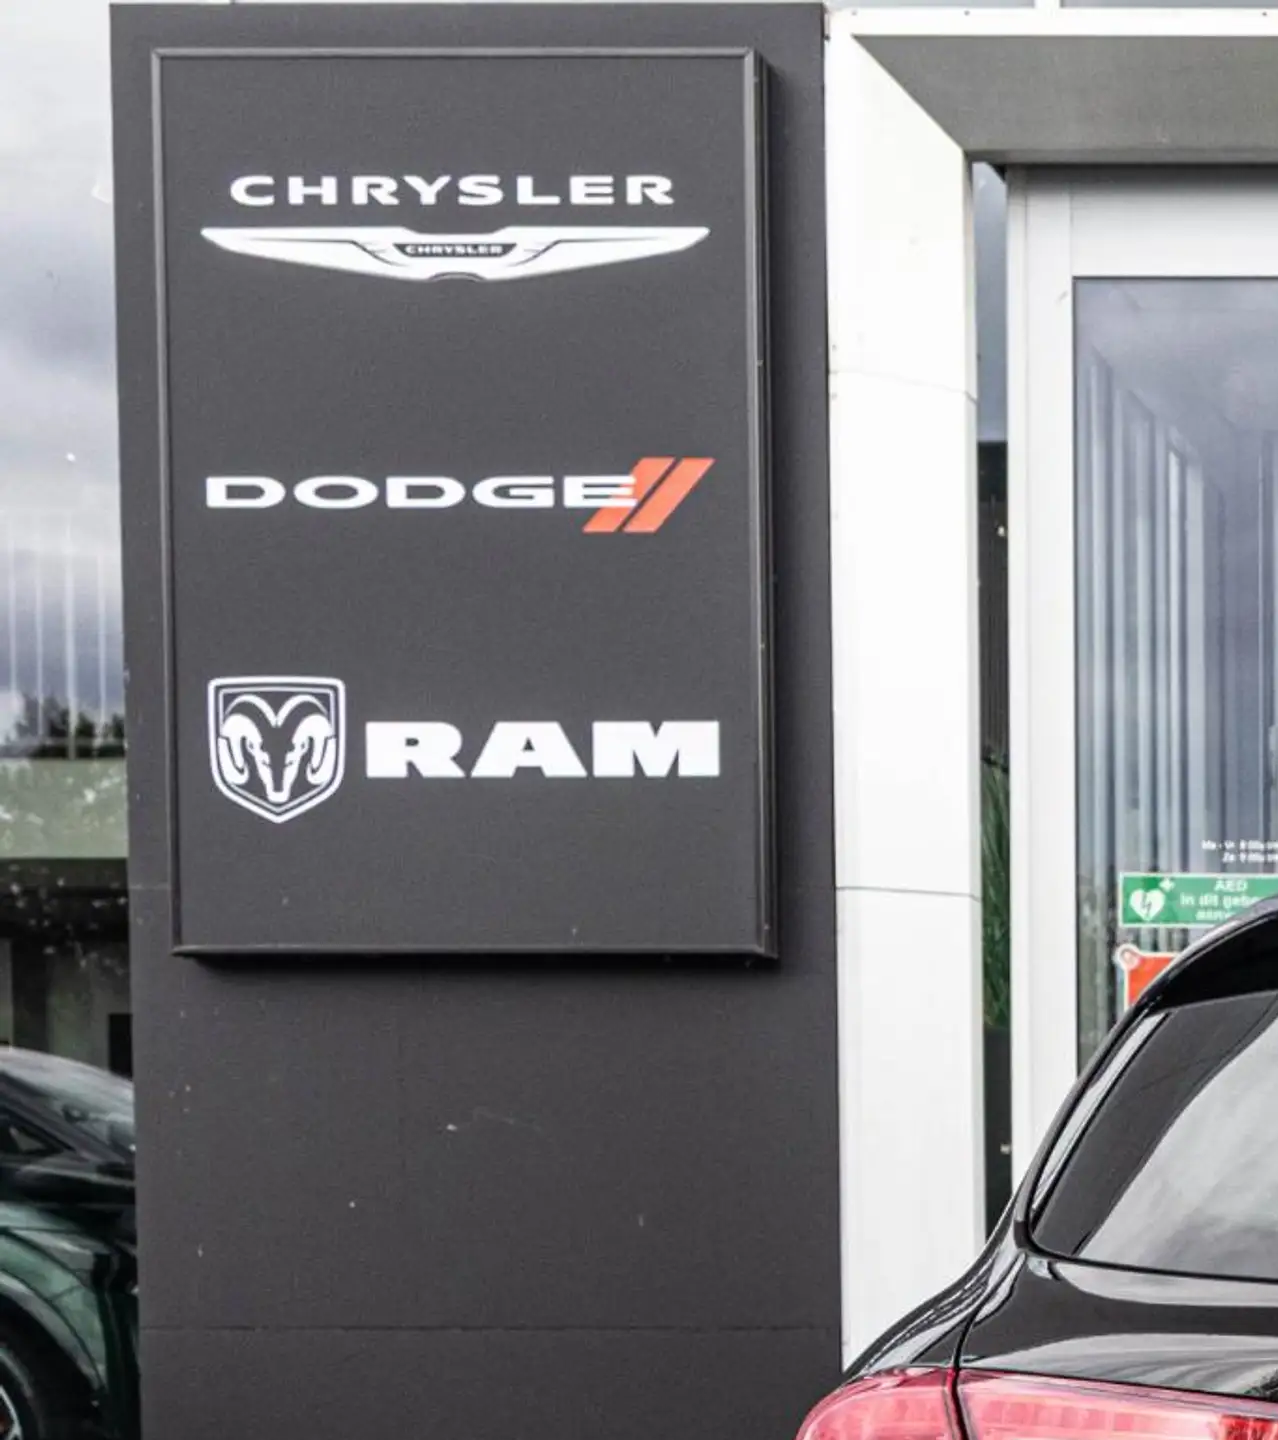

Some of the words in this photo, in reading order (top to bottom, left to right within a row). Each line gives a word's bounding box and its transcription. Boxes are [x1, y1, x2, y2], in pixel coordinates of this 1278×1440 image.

[230, 175, 675, 206] CHRYSLER
[405, 245, 504, 255] CHRYSLER
[206, 476, 638, 508] DODGE
[366, 721, 720, 778] RAM
[1213, 879, 1249, 893] AED
